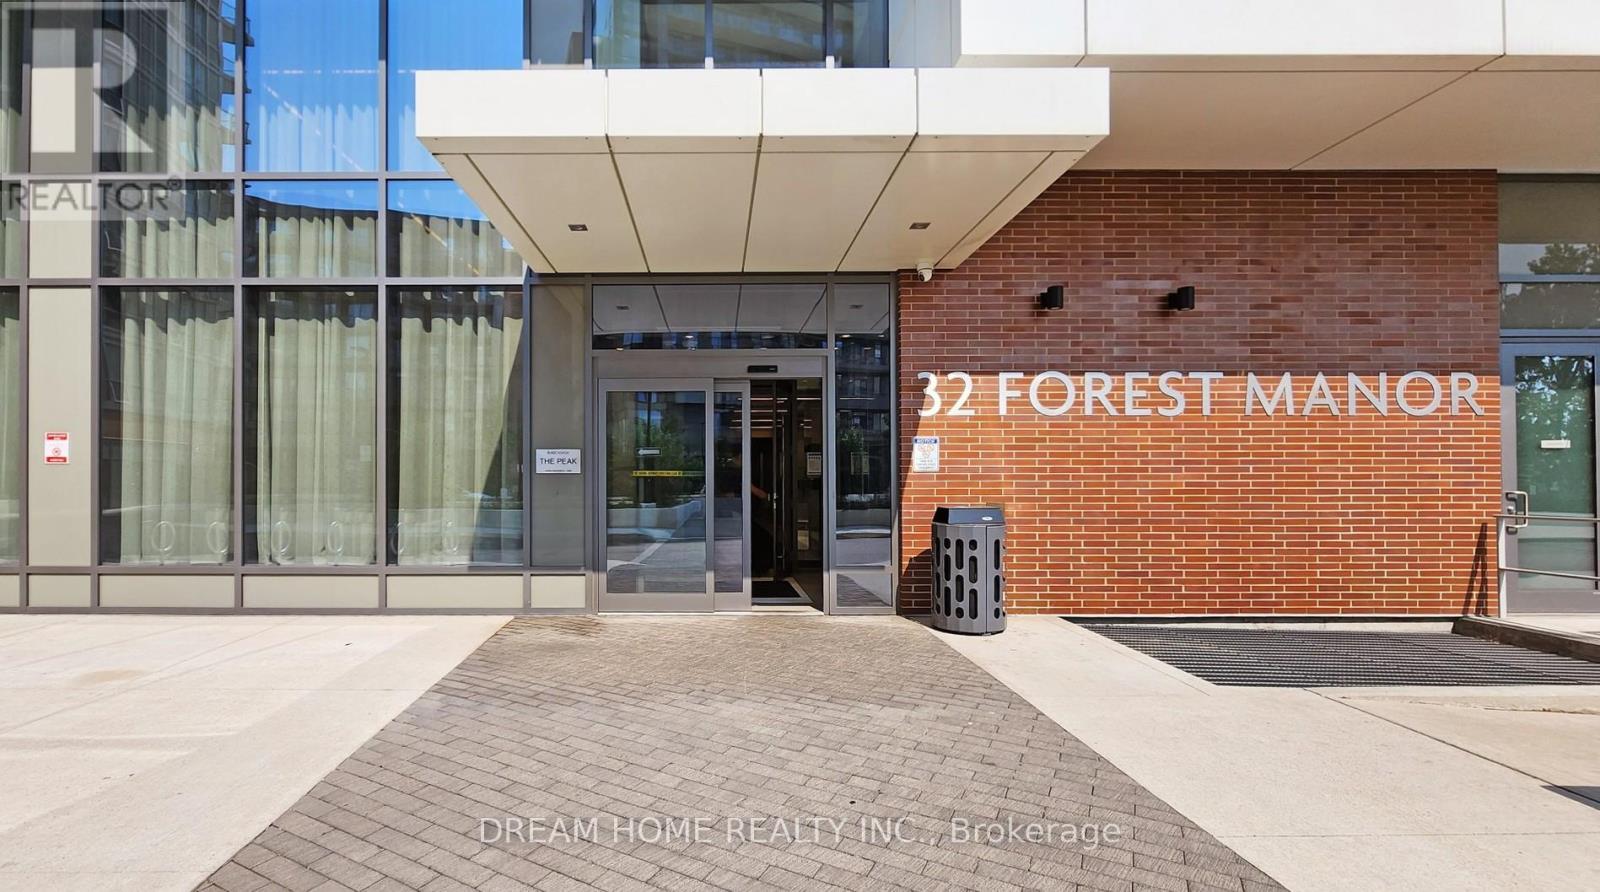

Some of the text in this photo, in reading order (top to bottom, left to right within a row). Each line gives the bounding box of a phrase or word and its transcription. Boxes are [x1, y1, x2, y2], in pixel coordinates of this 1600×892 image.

[917, 371, 1485, 416] 32 FOREST MANOR
